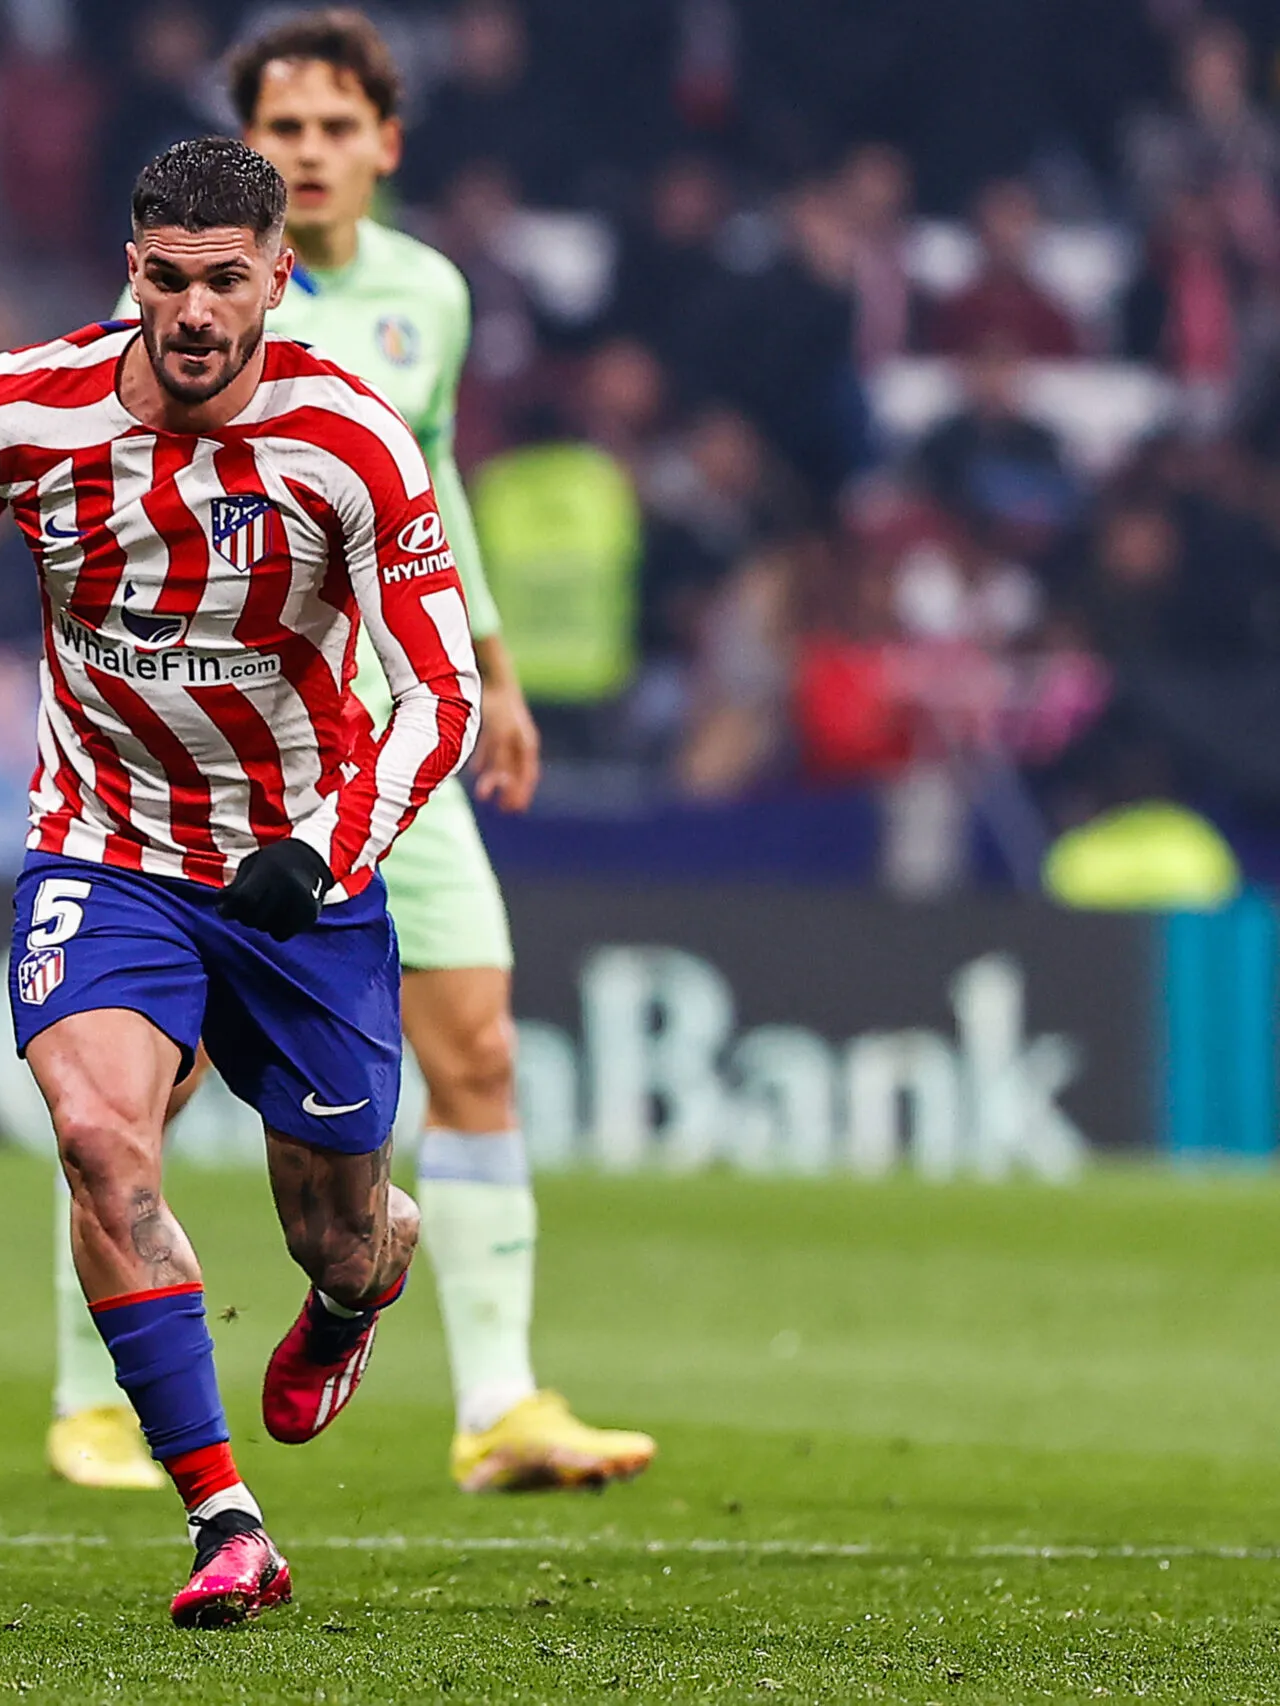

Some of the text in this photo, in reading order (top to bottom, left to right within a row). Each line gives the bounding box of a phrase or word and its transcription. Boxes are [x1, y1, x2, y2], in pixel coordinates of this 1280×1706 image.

[382, 549, 456, 585] HYUND
[58, 608, 278, 682] WhaleFin.com
[26, 878, 92, 951] 5
